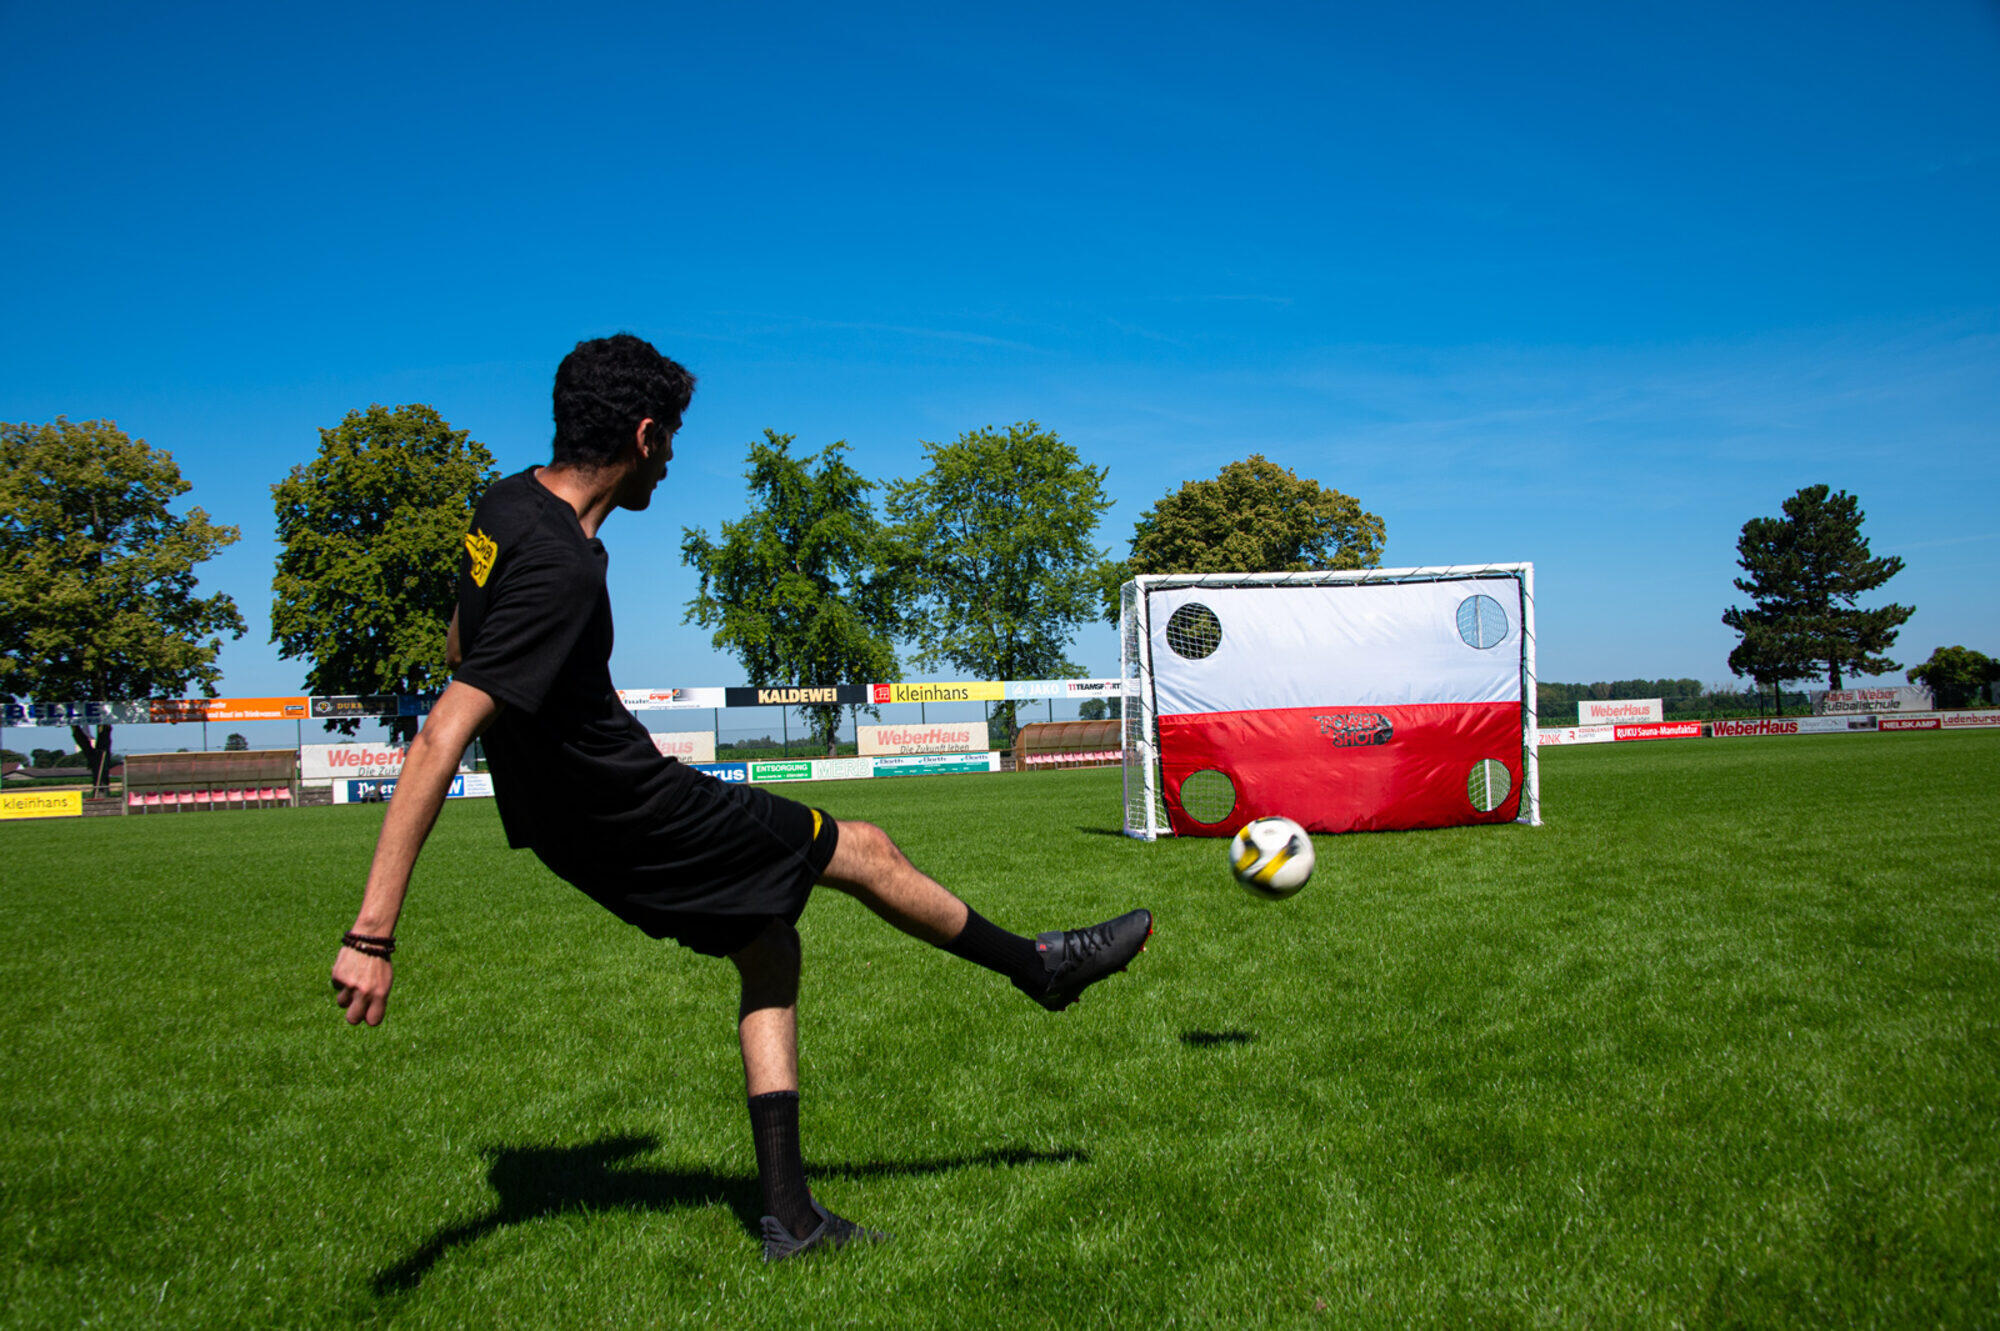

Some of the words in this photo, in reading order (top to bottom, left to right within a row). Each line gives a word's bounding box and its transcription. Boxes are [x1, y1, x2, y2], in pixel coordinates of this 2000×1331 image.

[758, 688, 838, 704] KALDEWEI
[896, 684, 969, 701] kleinhans
[1029, 683, 1060, 696] JAKO
[1823, 690, 1853, 702] Hans
[1857, 688, 1898, 700] Weber
[1590, 704, 1651, 717] WeberHaus
[1320, 713, 1379, 731] POWER
[1713, 719, 1798, 736] WeberHaus
[1883, 720, 1937, 729] NELSKAMP
[877, 729, 970, 745] WeberHaus
[1638, 725, 1698, 737] Sauna-Manufaktur
[1334, 730, 1377, 746] SHOT
[1538, 734, 1561, 745] ZINK
[756, 764, 808, 773] ENTSORGUNG
[3, 797, 68, 809] kleinhans
